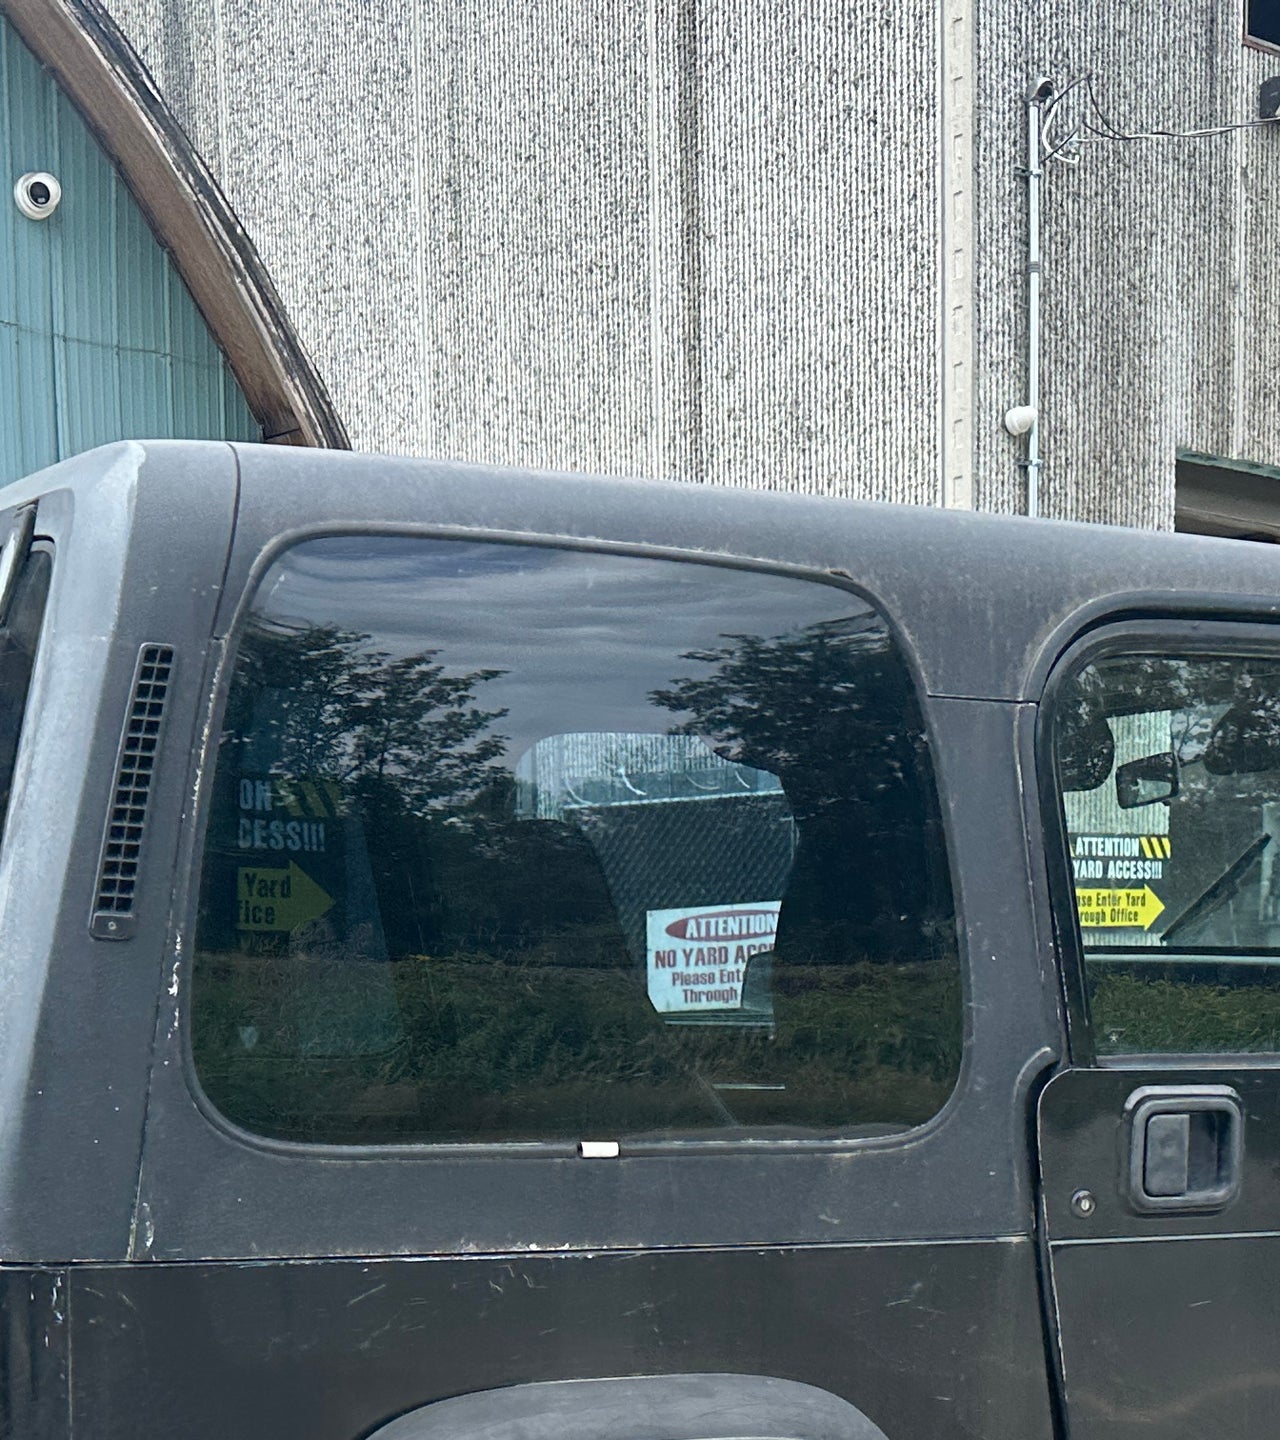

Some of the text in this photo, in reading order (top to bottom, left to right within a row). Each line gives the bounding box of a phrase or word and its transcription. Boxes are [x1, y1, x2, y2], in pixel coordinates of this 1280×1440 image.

[1075, 836, 1140, 857] ATTENTION
[1073, 860, 1162, 879] YARD ACCESS!!!
[245, 872, 292, 898] Yard
[1096, 892, 1122, 907] Enter
[1125, 892, 1146, 907] Yard
[1110, 908, 1139, 923] Office
[685, 912, 779, 939] ATTENTION
[655, 950, 677, 969] NO
[682, 946, 729, 967] YARD
[672, 969, 743, 987] Please Ent
[683, 986, 737, 1004] Through
